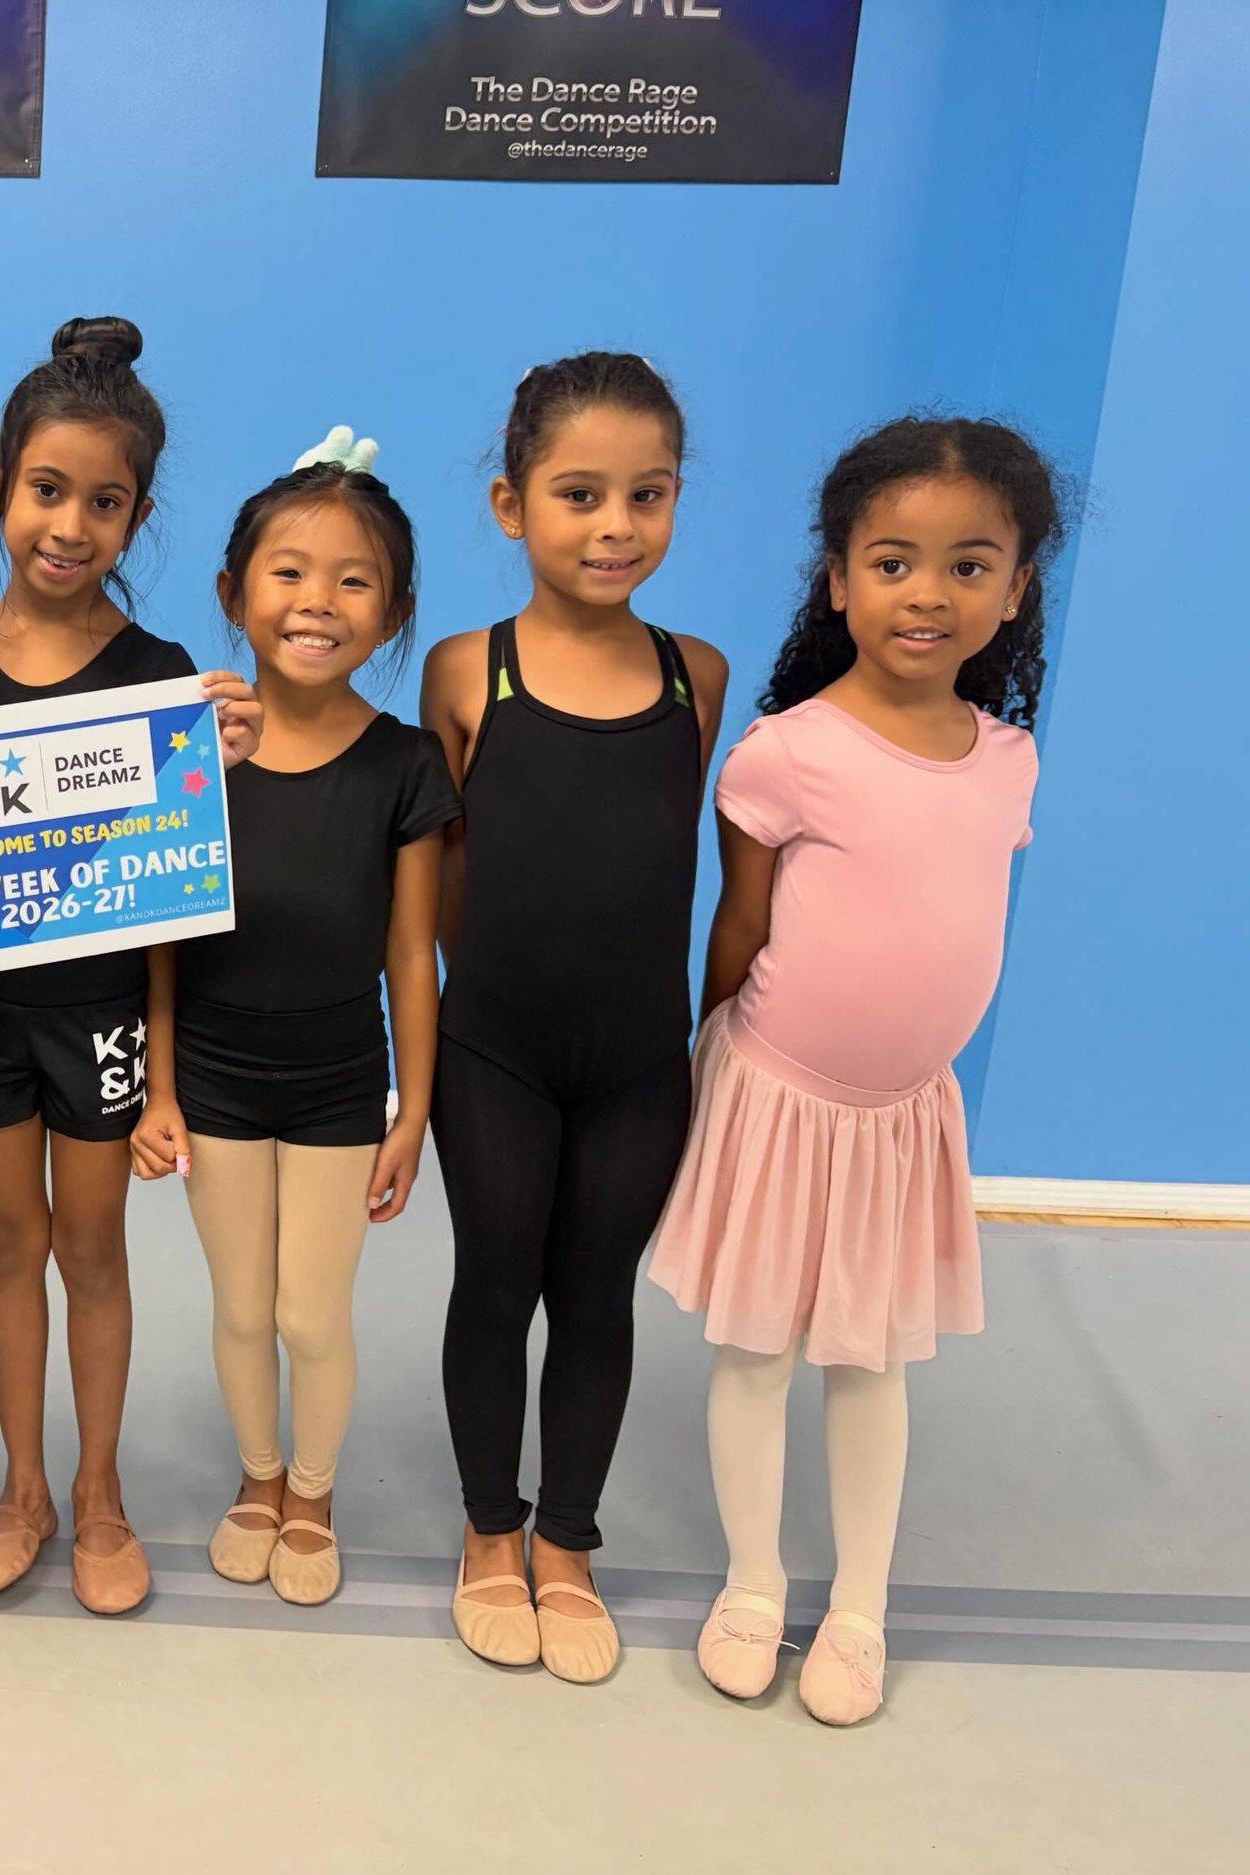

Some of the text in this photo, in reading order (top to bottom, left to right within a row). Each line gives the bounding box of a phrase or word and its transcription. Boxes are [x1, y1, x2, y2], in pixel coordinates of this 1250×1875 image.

[470, 76, 698, 109] The Dance Rage
[444, 106, 717, 139] Dance Competition
[507, 139, 648, 162] @thedancerage
[54, 748, 125, 773] DANCE
[56, 765, 142, 793] DREAMZ
[39, 829, 67, 848] TO
[71, 814, 151, 845] SEASON
[155, 808, 189, 831] 24!
[70, 858, 110, 889] OF
[120, 840, 226, 881] DANCE
[1, 883, 137, 929] 2026-27!
[92, 1025, 129, 1065] K
[101, 1099, 130, 1115] DANCE
